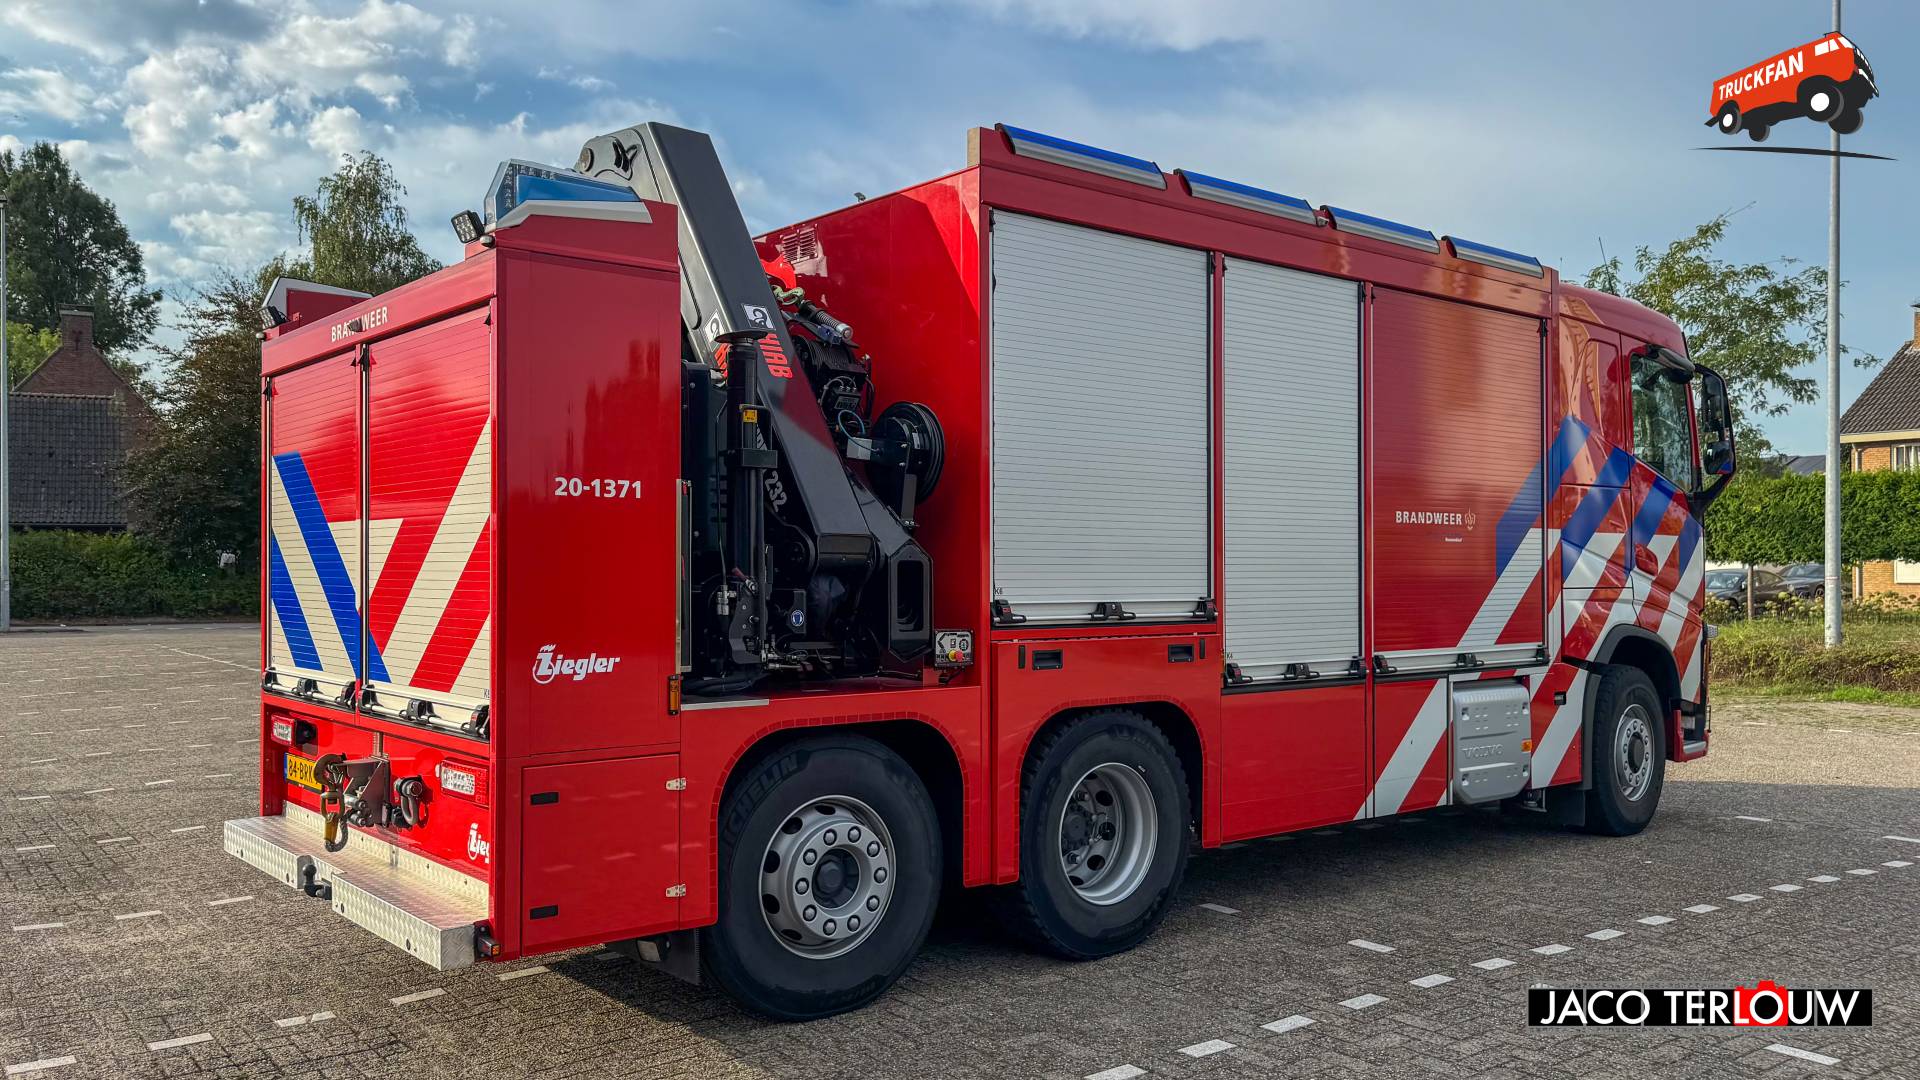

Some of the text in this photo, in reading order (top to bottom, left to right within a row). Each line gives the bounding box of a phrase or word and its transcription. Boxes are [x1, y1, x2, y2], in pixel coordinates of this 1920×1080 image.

[554, 476, 642, 499] 20-1371
[764, 470, 788, 513] 232
[1395, 510, 1462, 526] BRANDWEER
[532, 644, 621, 684] Ziegler
[1461, 743, 1504, 760] VOLVO
[722, 751, 799, 847] ICHELIN
